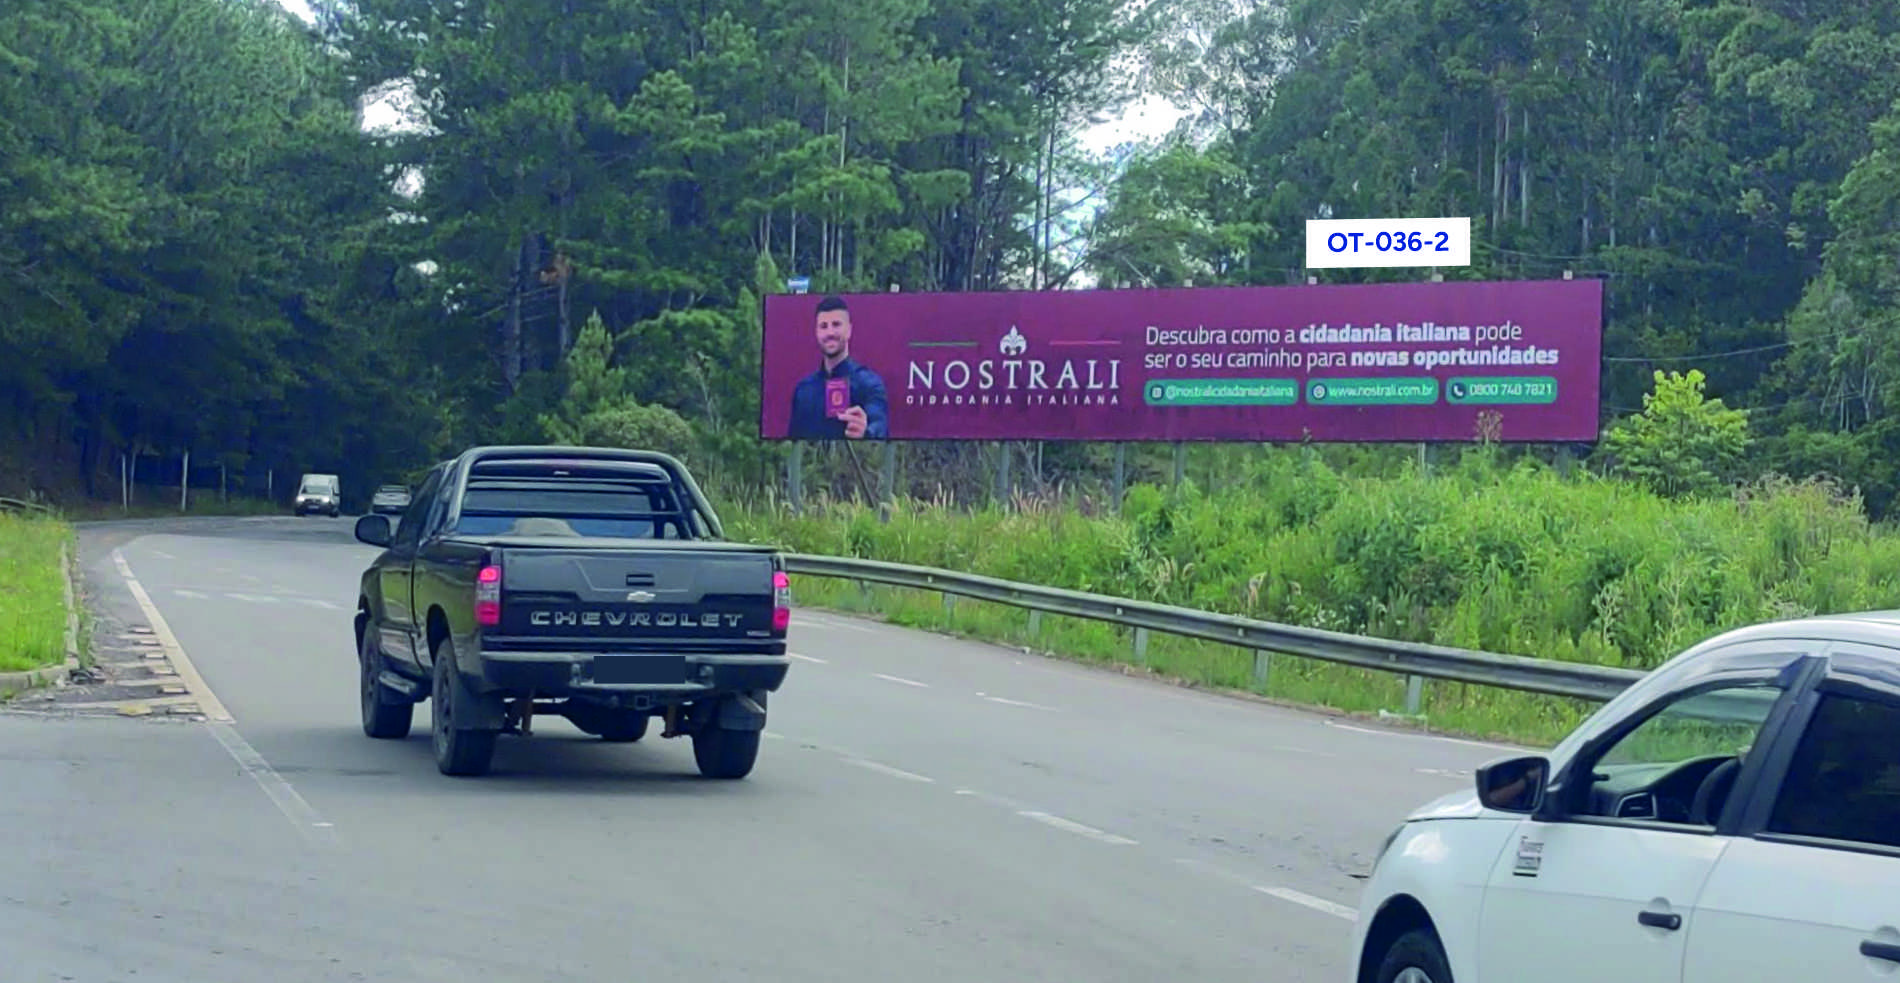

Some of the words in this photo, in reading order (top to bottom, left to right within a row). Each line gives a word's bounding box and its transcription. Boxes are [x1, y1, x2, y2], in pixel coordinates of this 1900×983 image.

[1146, 326, 1227, 346] Descubra
[1231, 328, 1281, 344] como
[1285, 328, 1296, 344] a
[1300, 323, 1392, 344] cidadania
[1396, 322, 1470, 342] italiana
[1475, 320, 1523, 346] pode
[1144, 352, 1172, 368] ser
[1175, 352, 1187, 368] o
[1191, 352, 1223, 368] seu
[1226, 347, 1302, 367] caminho
[1306, 351, 1347, 372] para
[1351, 349, 1410, 367] novas
[1413, 344, 1560, 370] oportunidades
[907, 359, 1121, 390] NOSTRALI
[1328, 384, 1434, 397] www.nostrali.com.br
[1469, 383, 1498, 396] 0800
[1525, 383, 1552, 396] 7821
[906, 395, 1013, 405] CIDADANIA
[1027, 395, 1119, 405] ITALIANA
[530, 610, 743, 628] CHEVROLET
